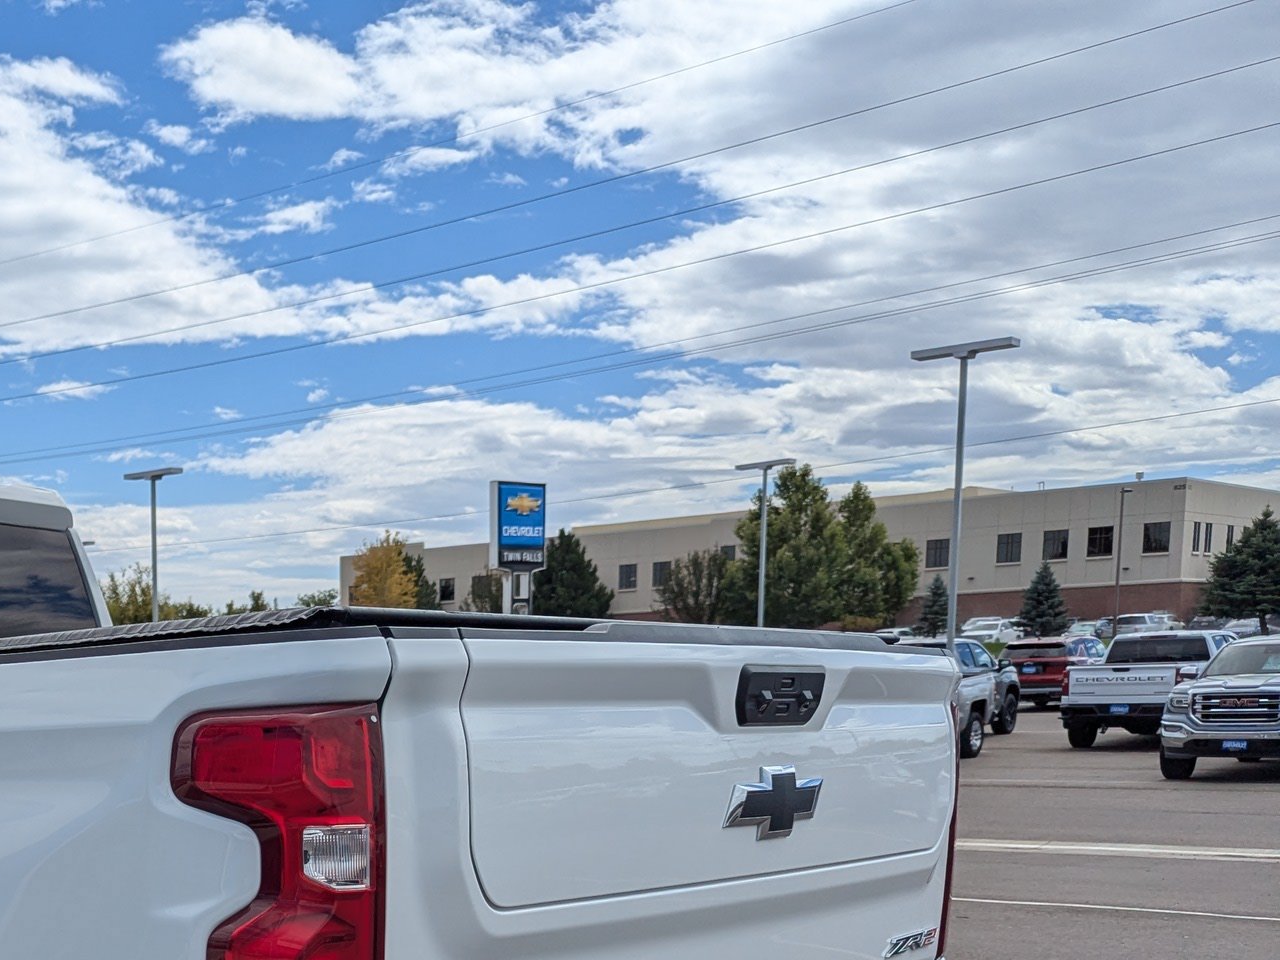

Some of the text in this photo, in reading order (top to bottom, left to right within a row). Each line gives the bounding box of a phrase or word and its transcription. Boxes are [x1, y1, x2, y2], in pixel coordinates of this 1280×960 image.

[502, 526, 543, 537] CHEVROLET
[503, 552, 543, 562] TWIN FALLS
[1075, 675, 1167, 683] CHEVROLET
[1220, 698, 1259, 707] GMC
